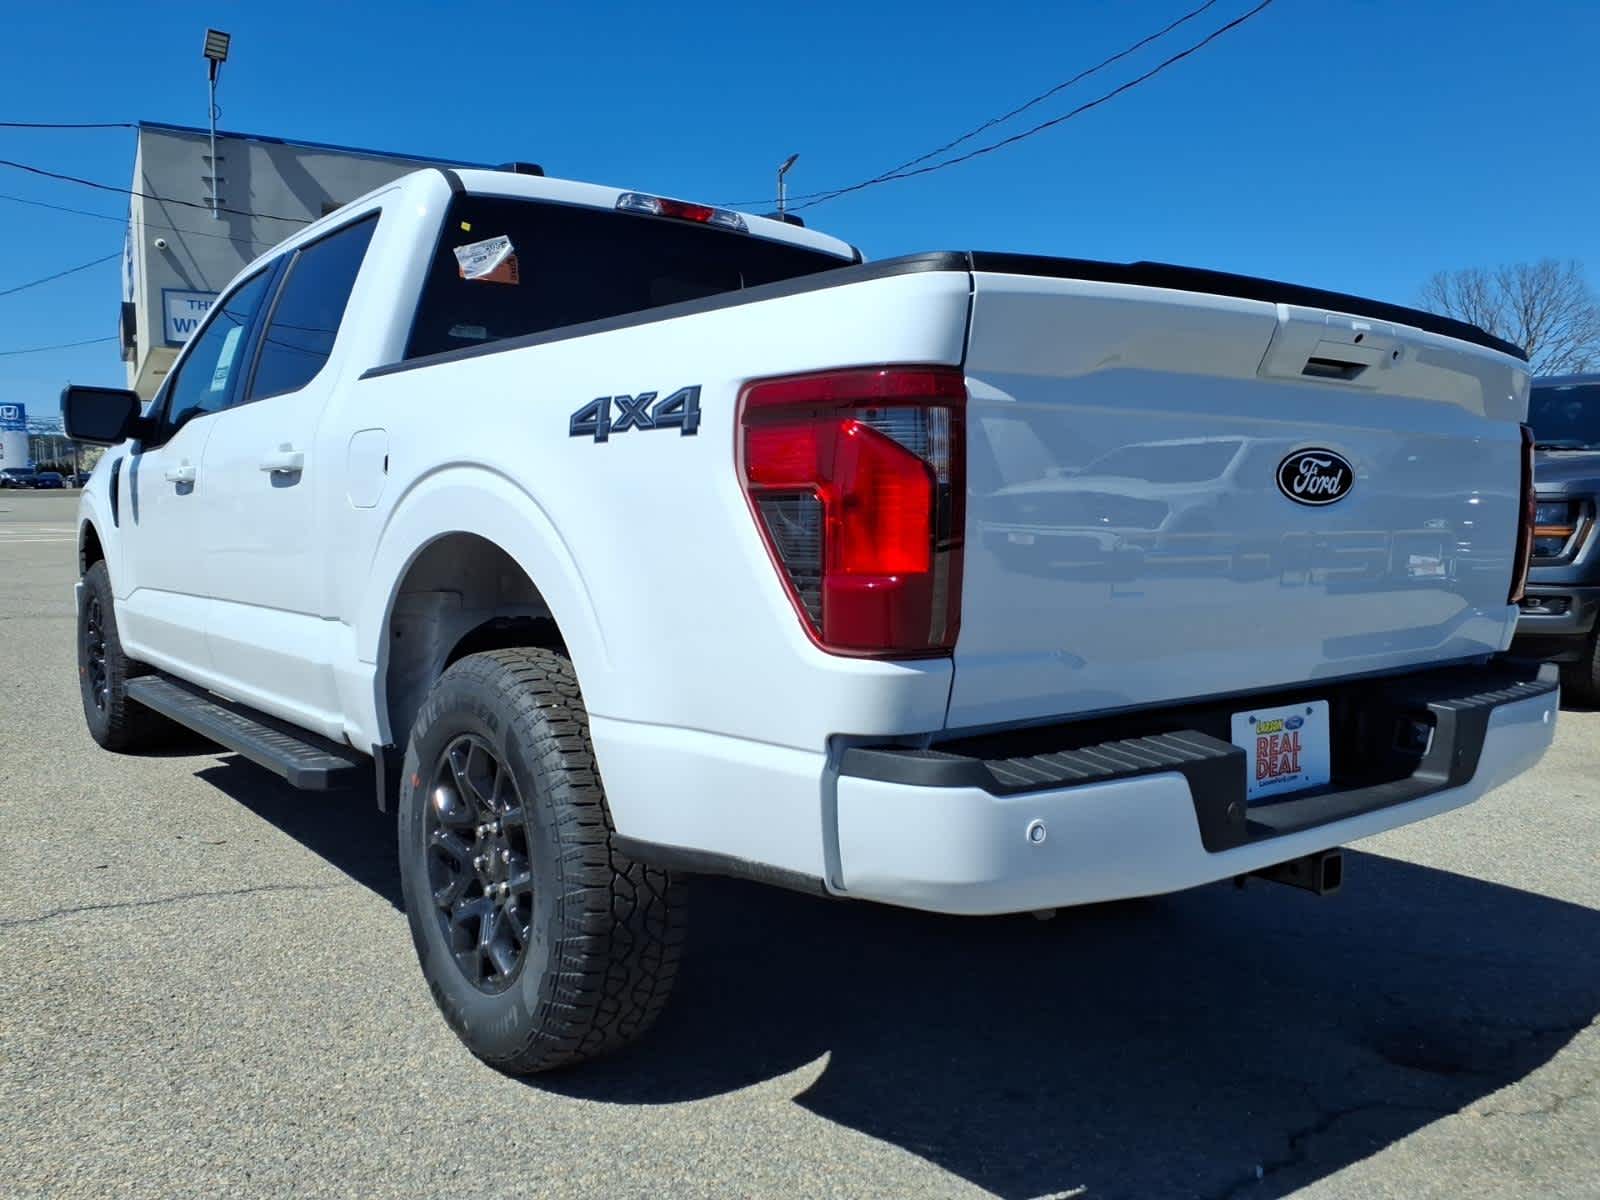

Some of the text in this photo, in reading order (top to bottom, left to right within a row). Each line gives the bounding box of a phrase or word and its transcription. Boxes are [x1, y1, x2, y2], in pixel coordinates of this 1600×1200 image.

[1293, 456, 1344, 495] Ford
[1256, 731, 1302, 758] REAL
[1256, 752, 1302, 780] DEAL
